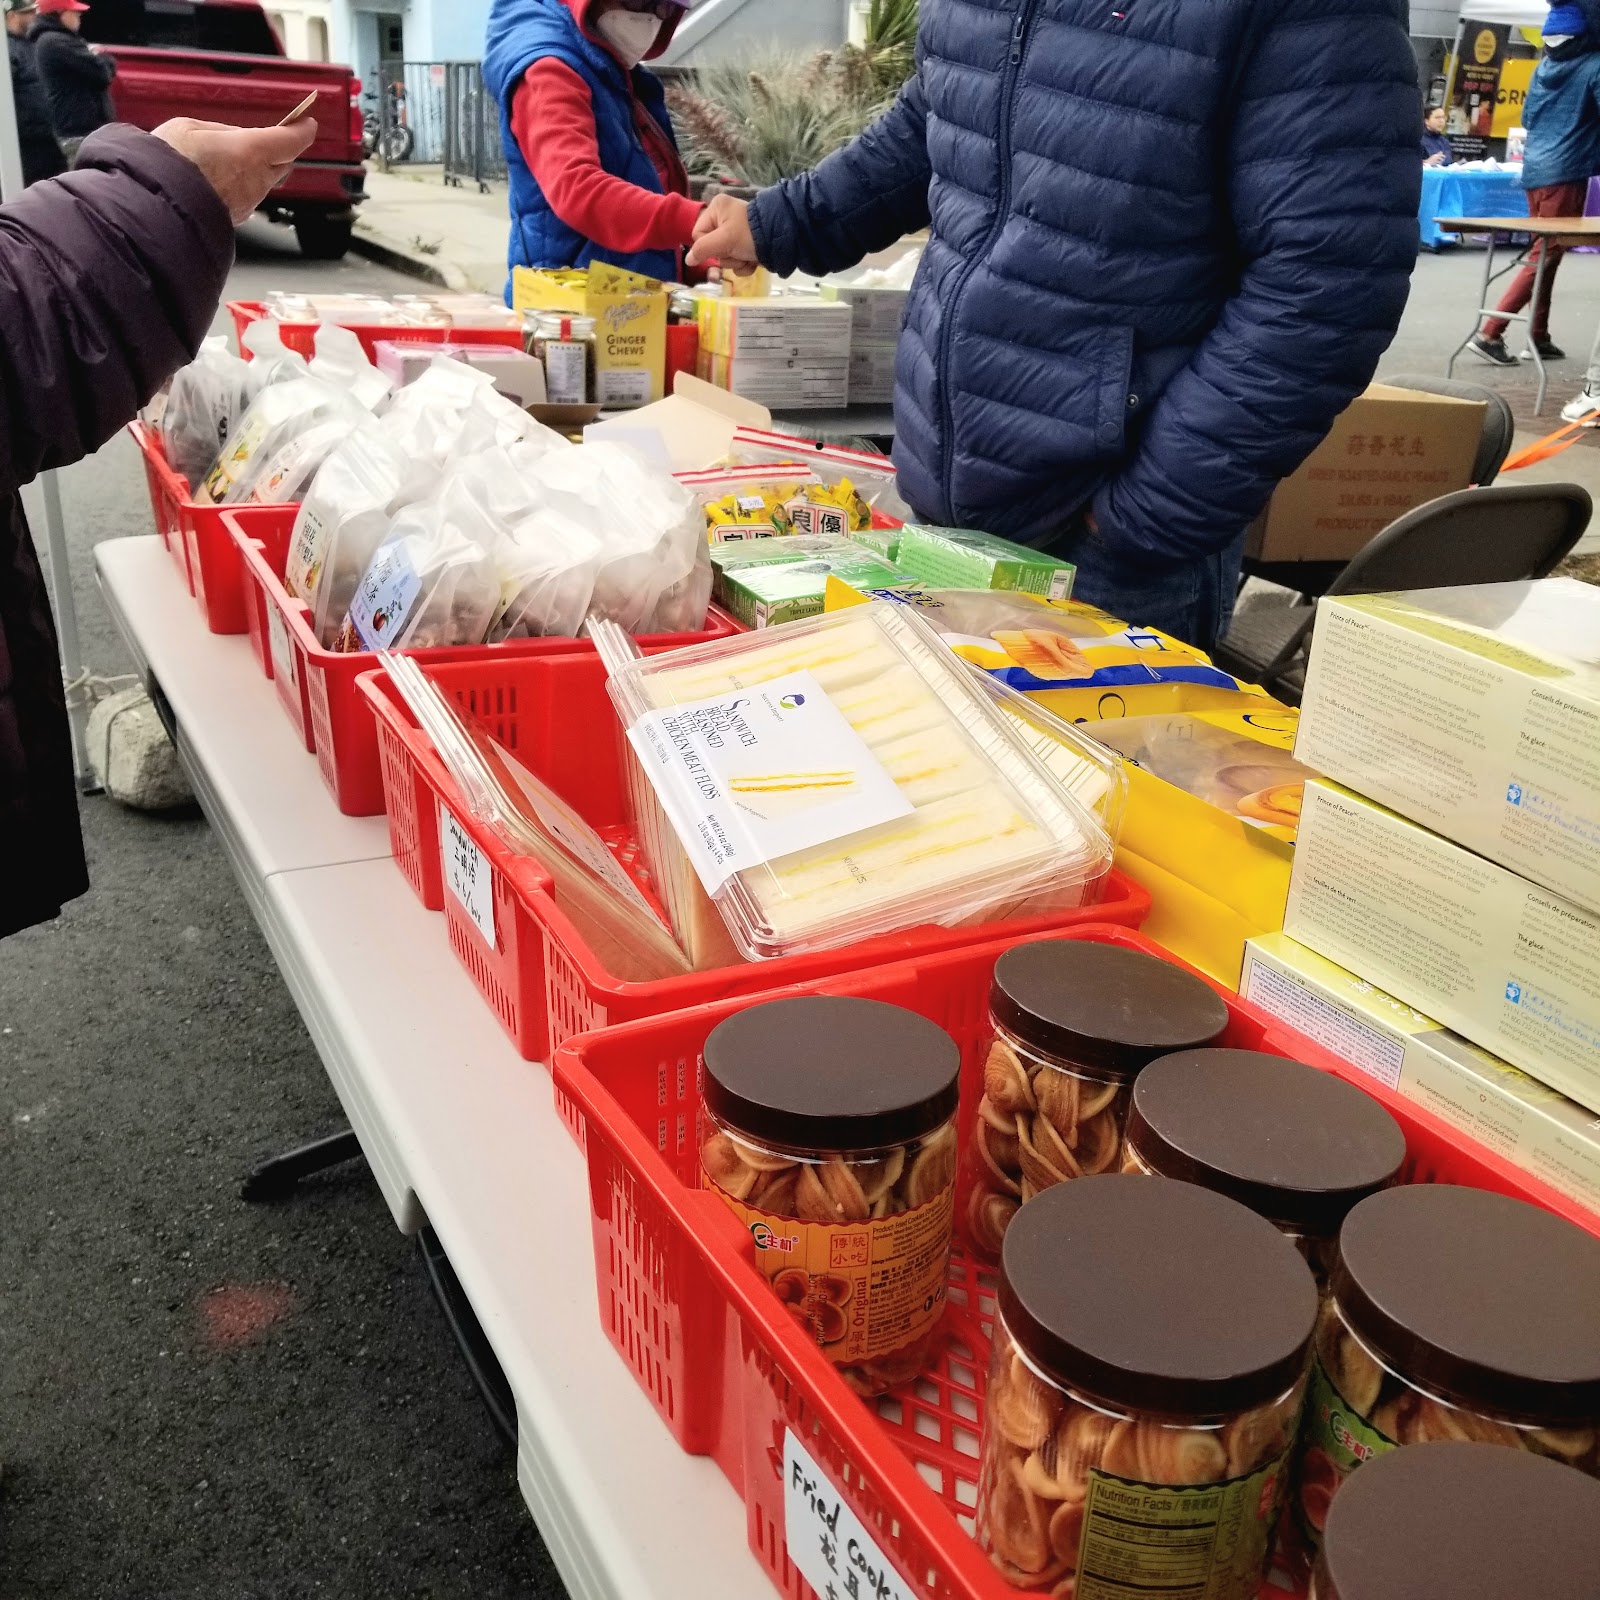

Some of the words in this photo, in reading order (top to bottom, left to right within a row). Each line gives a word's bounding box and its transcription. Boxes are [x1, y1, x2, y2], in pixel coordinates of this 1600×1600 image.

[606, 334, 646, 345] GINGER
[608, 345, 645, 355] CHEWS
[1530, 688, 1554, 704] Conseils
[1554, 697, 1563, 708] de
[677, 711, 700, 736] WITH
[690, 709, 725, 749] SEASONED
[705, 706, 731, 733] BREAD
[720, 698, 758, 748] SANDWICH
[1519, 730, 1529, 742] Thé
[661, 715, 691, 752] CHICKEN
[681, 750, 702, 776] MEAT
[694, 774, 721, 800] FLOSS
[1330, 884, 1336, 894] de
[1346, 893, 1356, 904] vert
[1527, 892, 1550, 910] Conseils
[1551, 903, 1559, 914] de
[1517, 932, 1527, 945] Thé
[853, 1275, 869, 1327] Original
[792, 1460, 841, 1542] Fried
[1096, 1484, 1140, 1508] Nutrition
[1142, 1496, 1172, 1511] Facts
[847, 1538, 900, 1600] Cook
